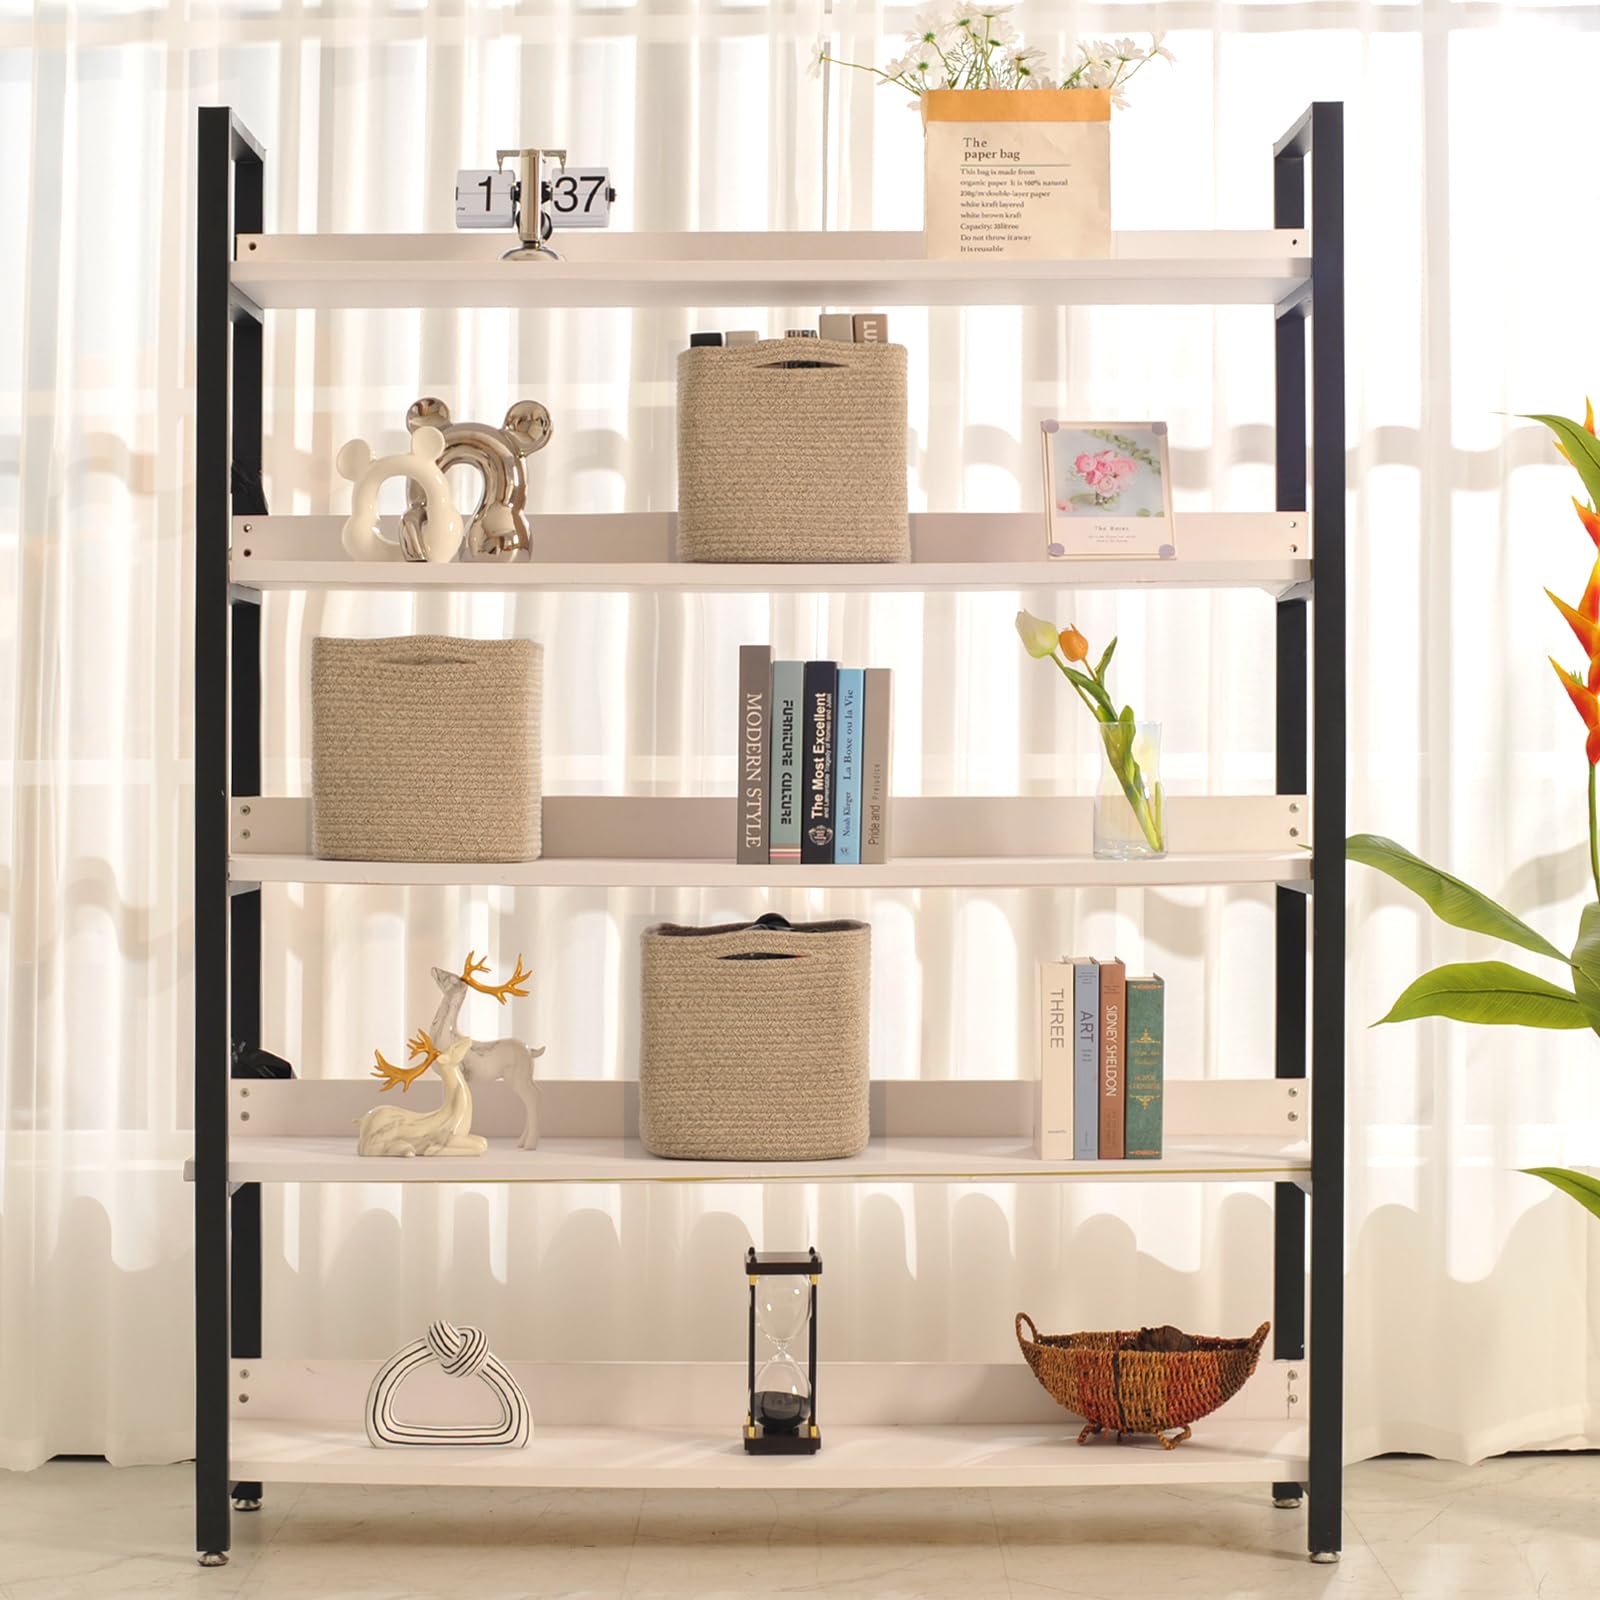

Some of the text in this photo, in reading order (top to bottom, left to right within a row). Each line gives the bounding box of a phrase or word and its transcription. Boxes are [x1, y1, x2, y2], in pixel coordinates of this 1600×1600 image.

[963, 137, 988, 148] The
[964, 148, 1021, 162] paper bag
[960, 179, 986, 187] organic
[977, 168, 990, 177] bag
[478, 176, 492, 212] 1
[553, 176, 606, 213] 37
[999, 201, 1025, 209] layered
[1030, 191, 1051, 199] paper
[960, 223, 993, 231] Capacity:
[1013, 235, 1032, 243] away
[843, 689, 854, 780] La Boxe ou la Vie
[780, 700, 794, 825] FURNITURE CULTURE
[811, 692, 826, 819] The Most Excellent
[745, 693, 763, 848] MODERN STYLE
[870, 805, 881, 821] and
[843, 817, 851, 837] Noah
[868, 823, 880, 845] Pride
[1050, 988, 1065, 1049] THREE
[1080, 1010, 1094, 1042] ART
[1105, 1004, 1118, 1043] SIDNEY
[1105, 1045, 1118, 1097] SHELDON
